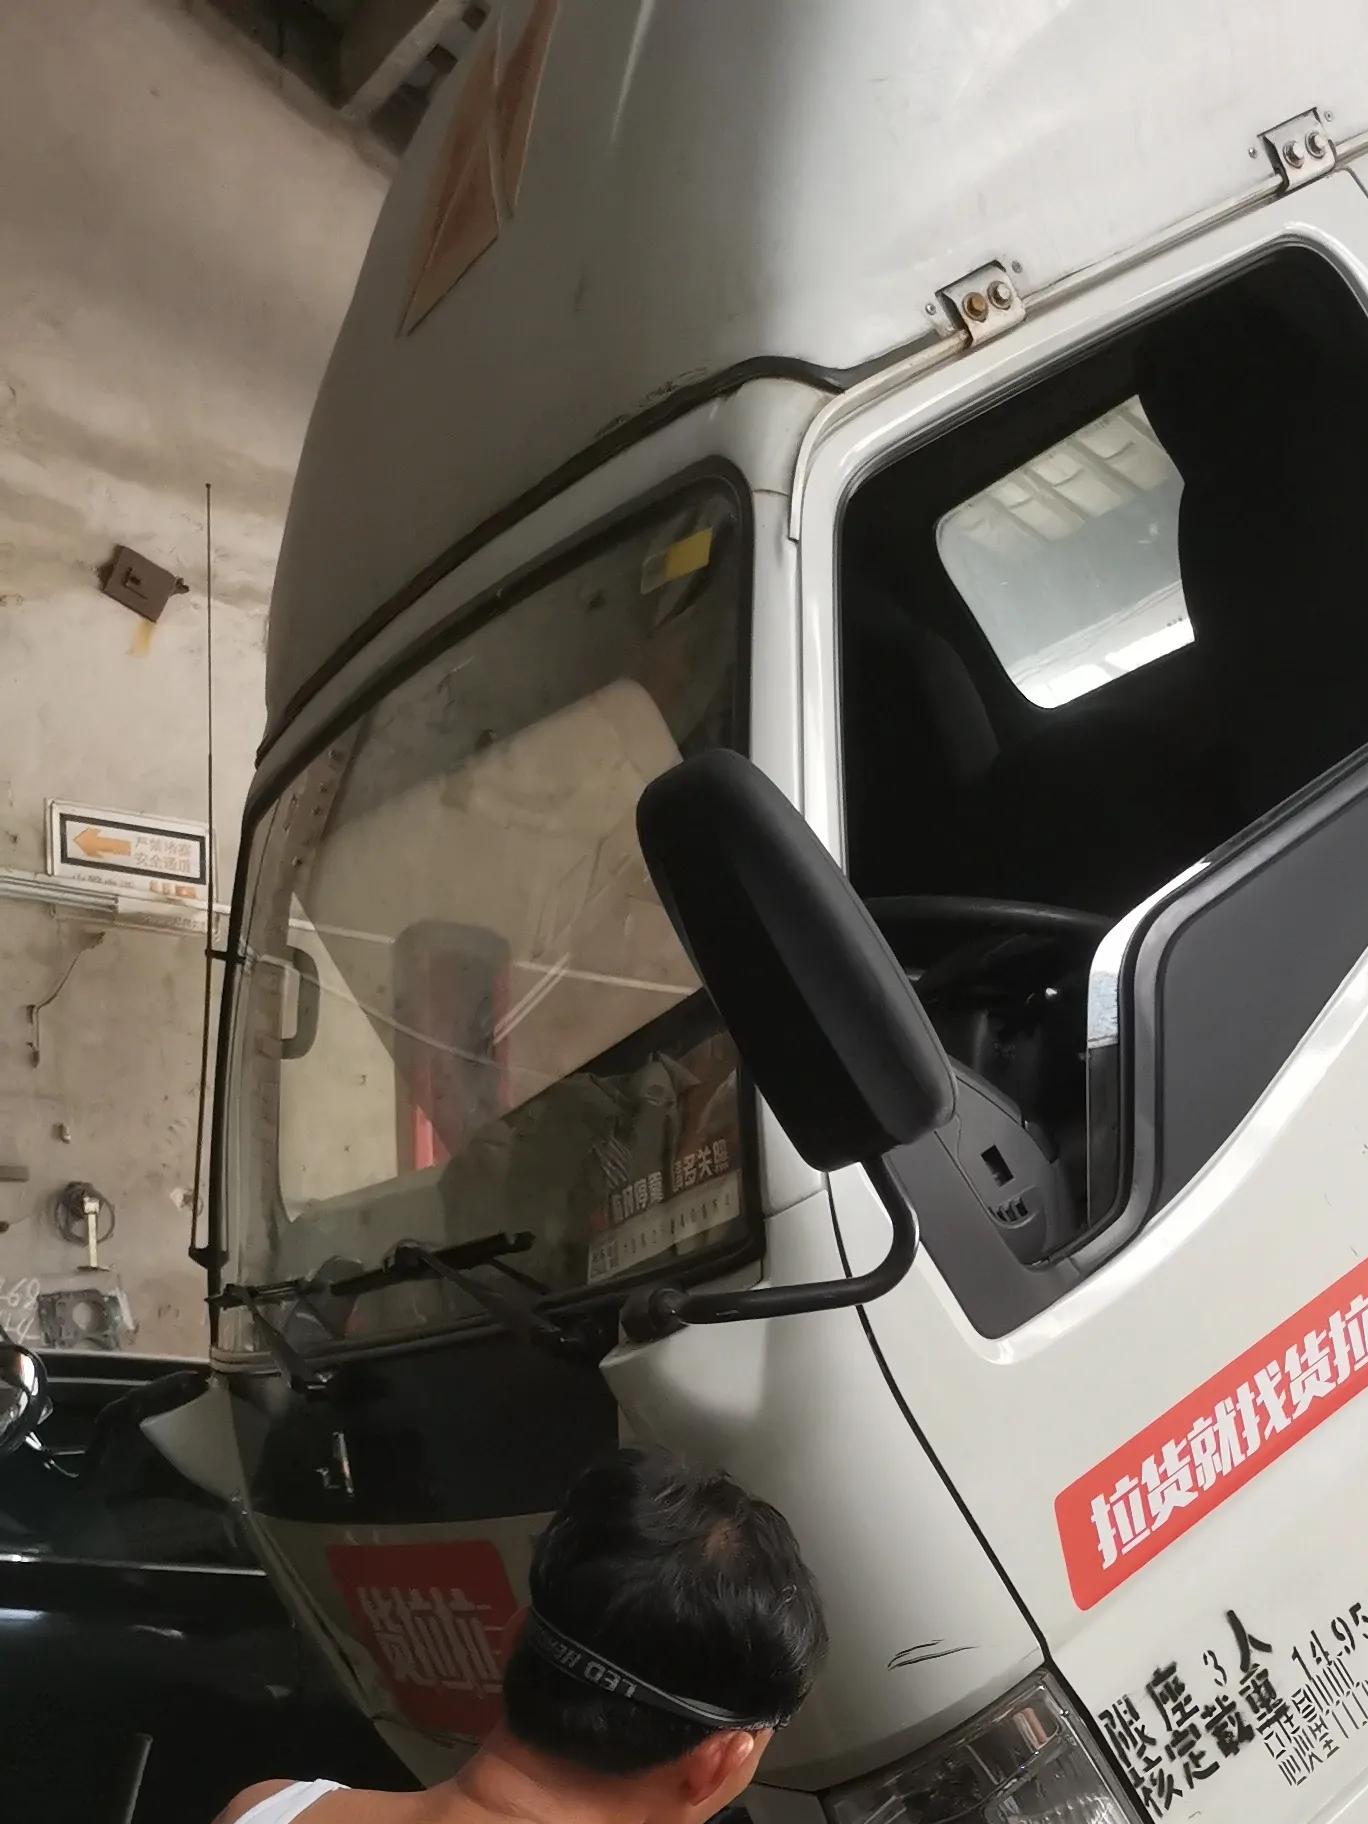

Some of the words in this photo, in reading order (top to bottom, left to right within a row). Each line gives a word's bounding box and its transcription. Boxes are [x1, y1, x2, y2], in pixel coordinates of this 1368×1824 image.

[135, 852, 192, 873] 安全通道
[583, 1660, 638, 1698] LED
